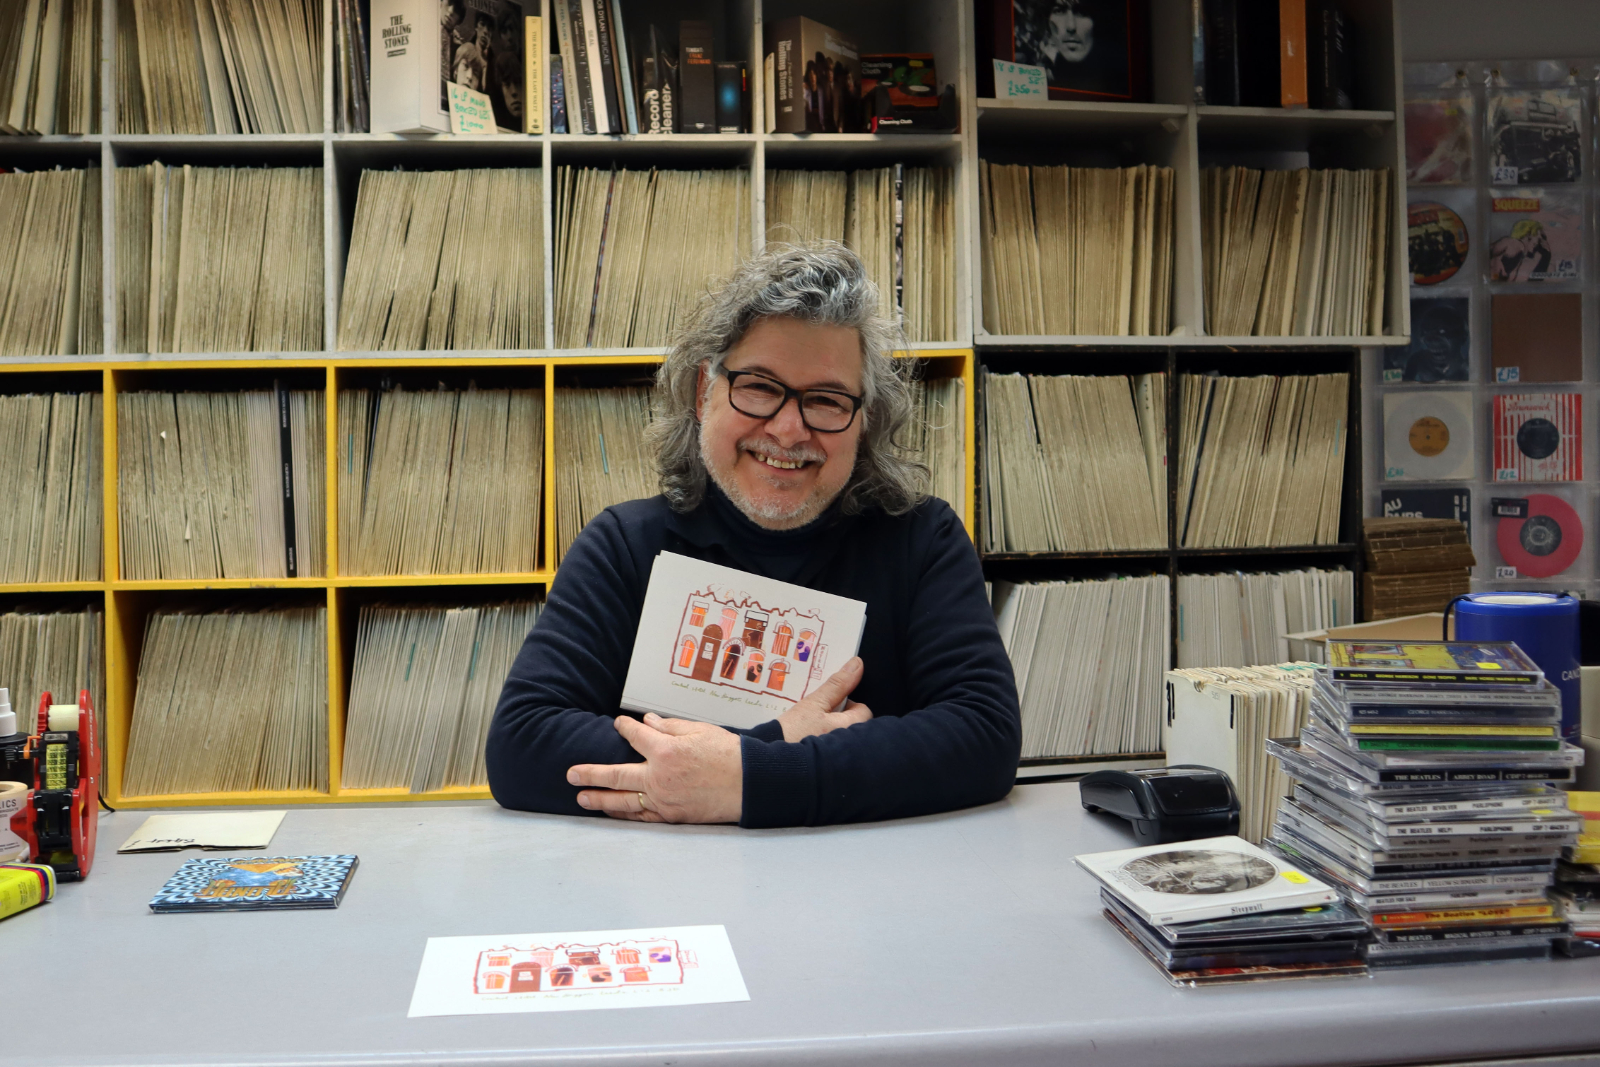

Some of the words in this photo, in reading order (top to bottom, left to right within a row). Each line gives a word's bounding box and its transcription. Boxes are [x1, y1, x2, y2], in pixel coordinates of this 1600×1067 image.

[390, 15, 404, 26] THE
[597, 10, 607, 32] DYLAN
[382, 24, 411, 39] ROLLING
[384, 35, 410, 49] STONES
[600, 33, 610, 65] TRIPLICATE
[778, 41, 788, 71] Rolling
[779, 71, 788, 101] Stones
[1494, 198, 1539, 211] SQUEEZE
[1384, 497, 1402, 511] AU
